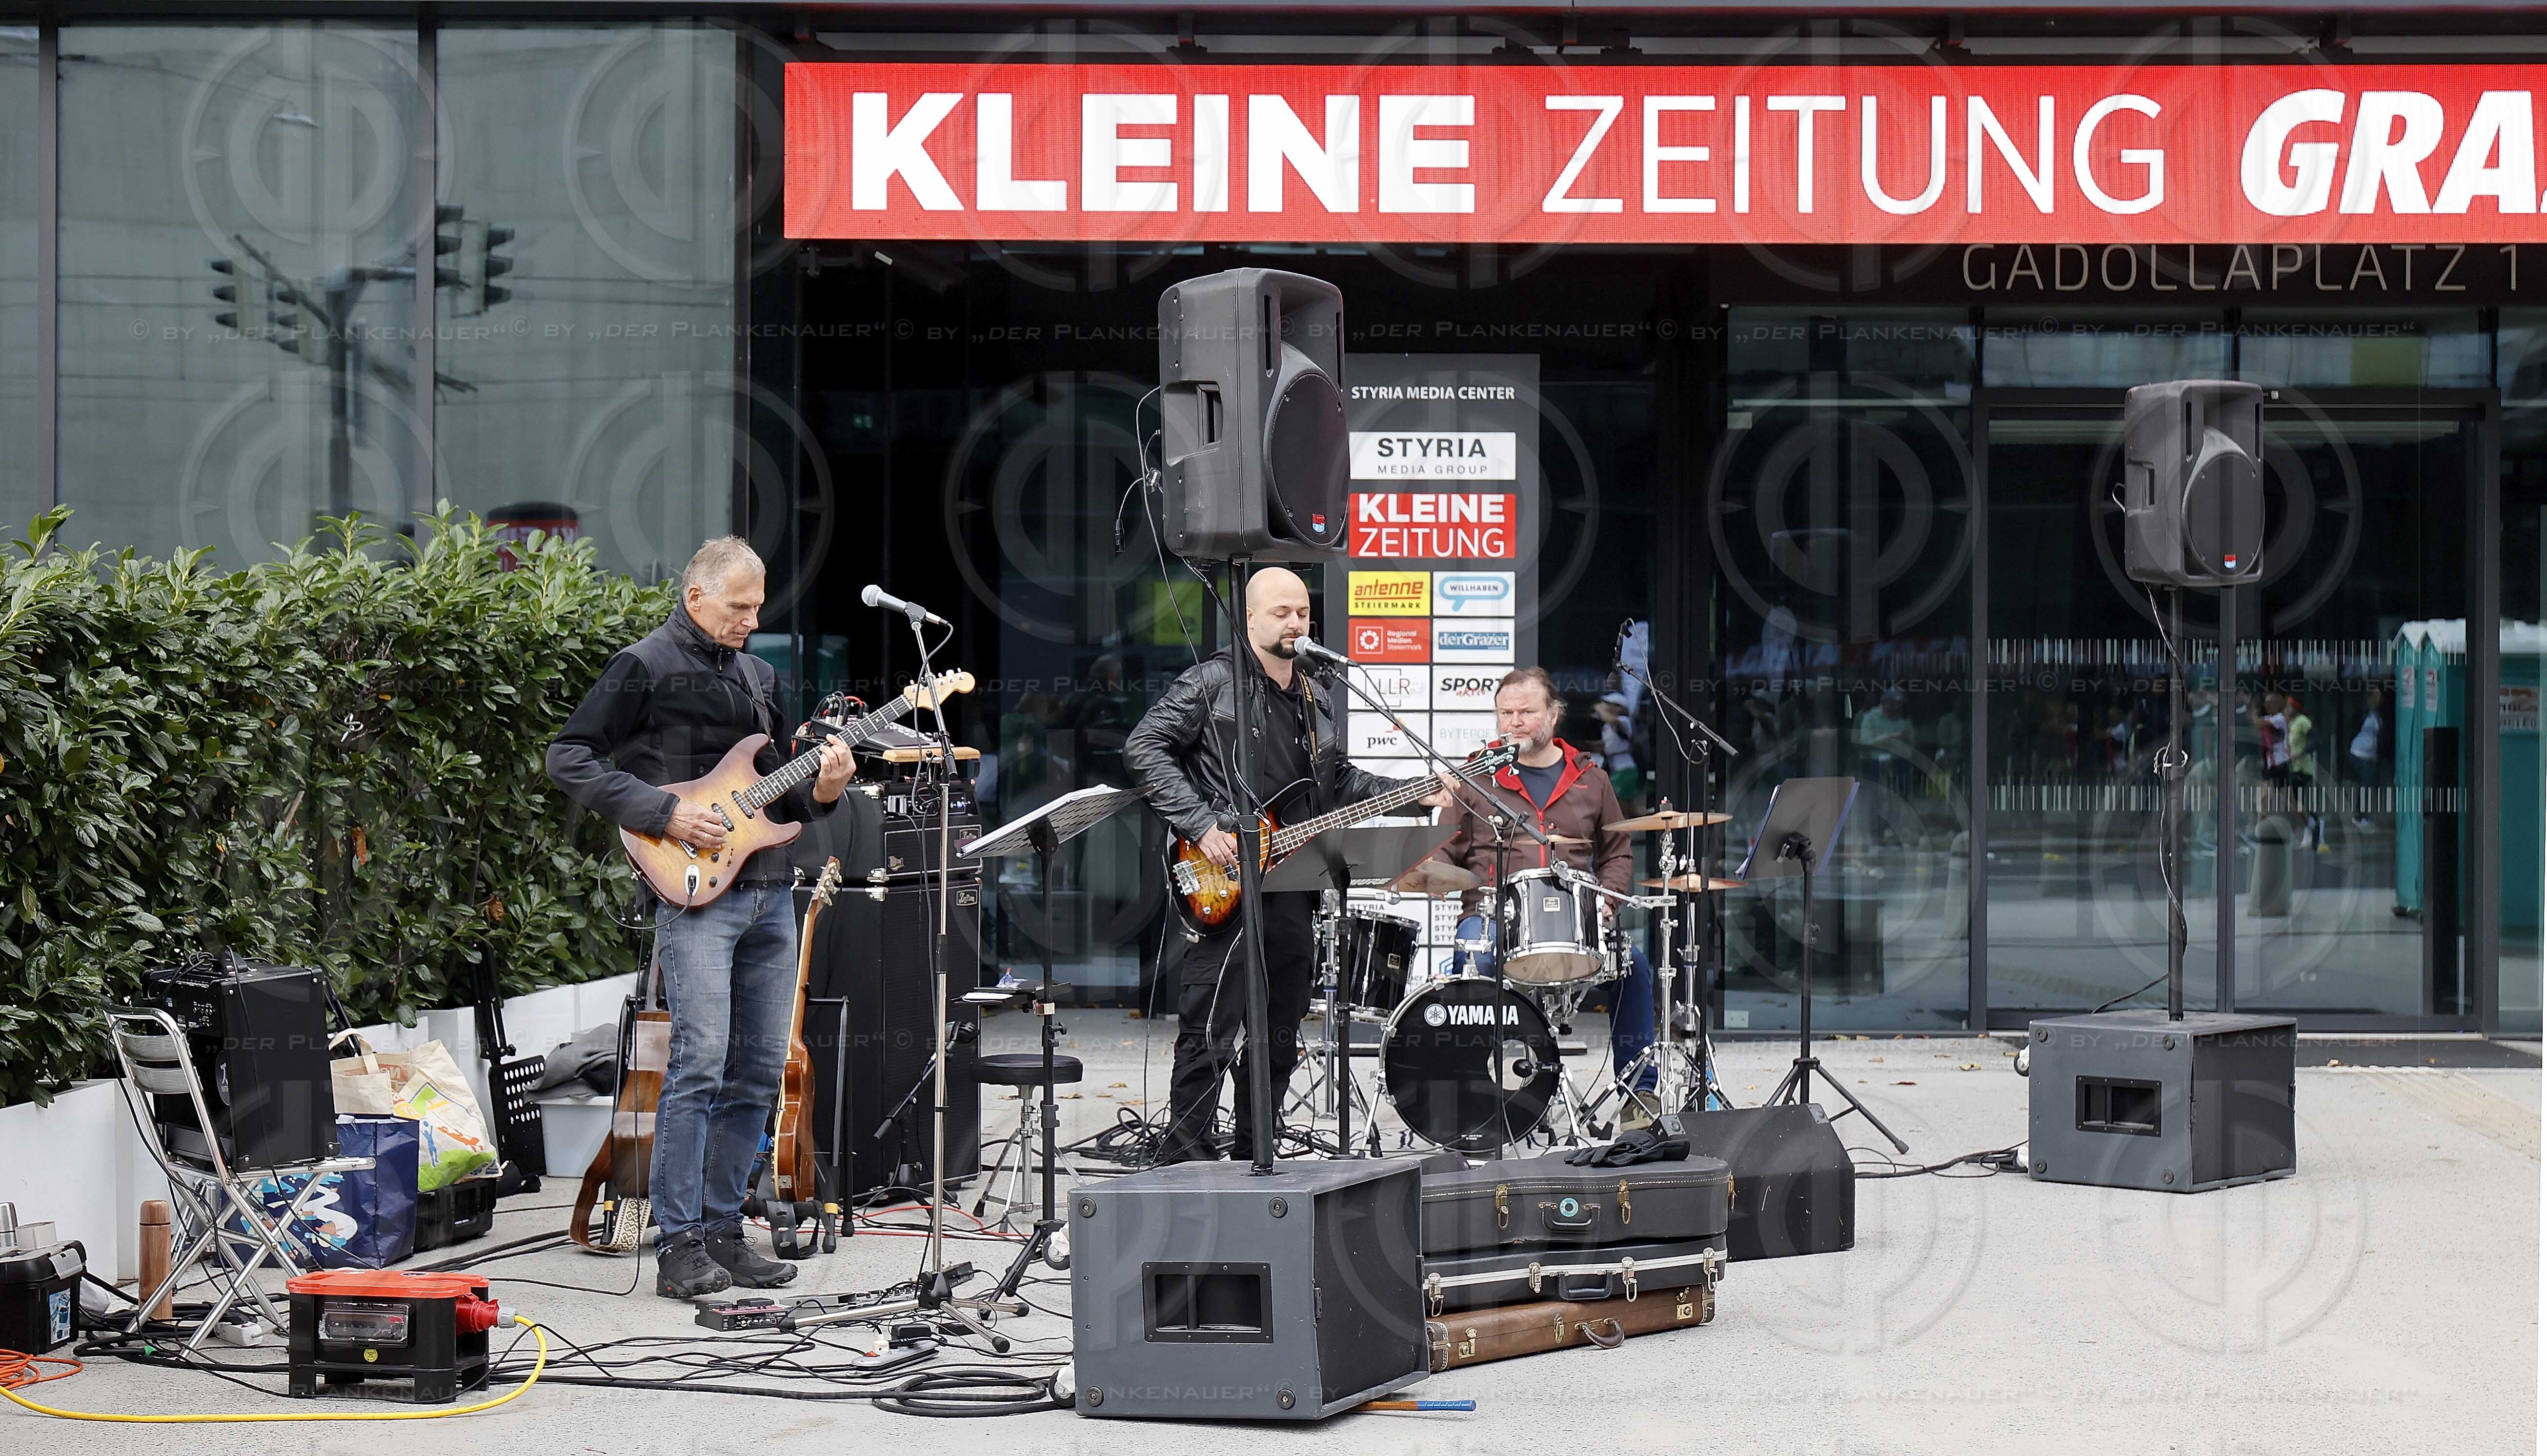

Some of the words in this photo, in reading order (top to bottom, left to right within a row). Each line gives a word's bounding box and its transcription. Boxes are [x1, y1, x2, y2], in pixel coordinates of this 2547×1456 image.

[852, 93, 1475, 213] KLEINE
[1542, 95, 2164, 215] ZEITUNG
[2241, 88, 2546, 216] GRA
[1963, 243, 2466, 291] GADOLLAPLATZ
[2500, 243, 2517, 291] 1
[1352, 386, 1403, 400] STYRIA
[1406, 386, 1455, 400] MEDIA
[1458, 386, 1515, 400] CENTER
[1377, 438, 1486, 458] STYRIA
[1378, 465, 1425, 474] MEDIA
[1435, 465, 1487, 474] GROUP
[1358, 493, 1505, 523] KLEINE
[1358, 527, 1504, 557] ZEITUNG
[1354, 579, 1424, 596] antenne
[1439, 632, 1508, 647] derGrazer
[1378, 678, 1410, 695] LLR
[1367, 737, 1397, 748] pwc
